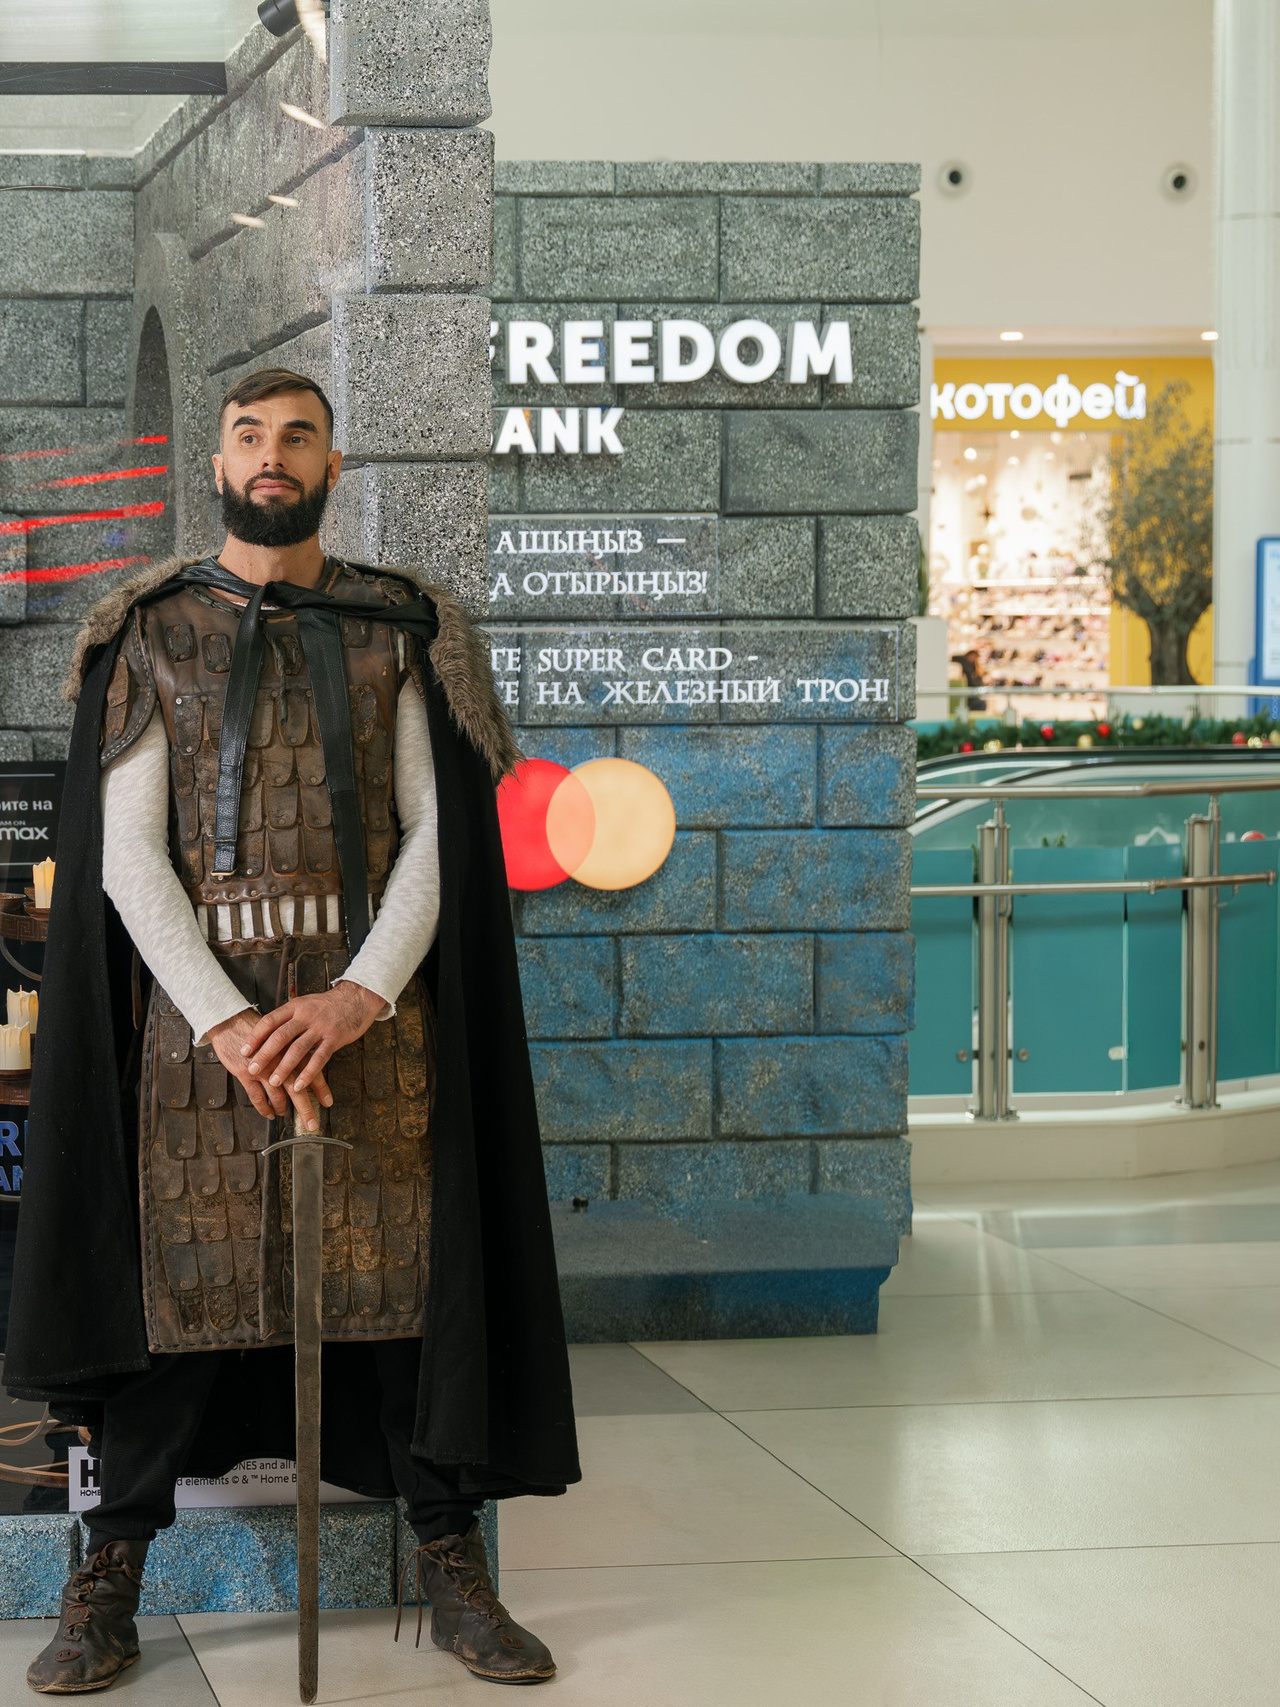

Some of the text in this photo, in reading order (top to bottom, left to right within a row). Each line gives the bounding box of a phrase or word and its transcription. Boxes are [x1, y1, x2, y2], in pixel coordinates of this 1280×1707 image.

[490, 319, 854, 384] REEDOM
[491, 407, 625, 454] ANK
[494, 528, 644, 559] АШЫҢЫЗ
[537, 647, 626, 674] SUPER
[641, 646, 732, 672] CARD
[536, 681, 585, 705] НА
[600, 675, 781, 706] ЖЕЛЕЗНЫЙ
[796, 677, 890, 704] ТРОН!
[32, 800, 53, 811] на
[260, 1459, 278, 1470] and
[280, 1459, 290, 1469] all
[185, 1476, 230, 1486] elements
[241, 1475, 249, 1484] &
[260, 1474, 289, 1484] Home
